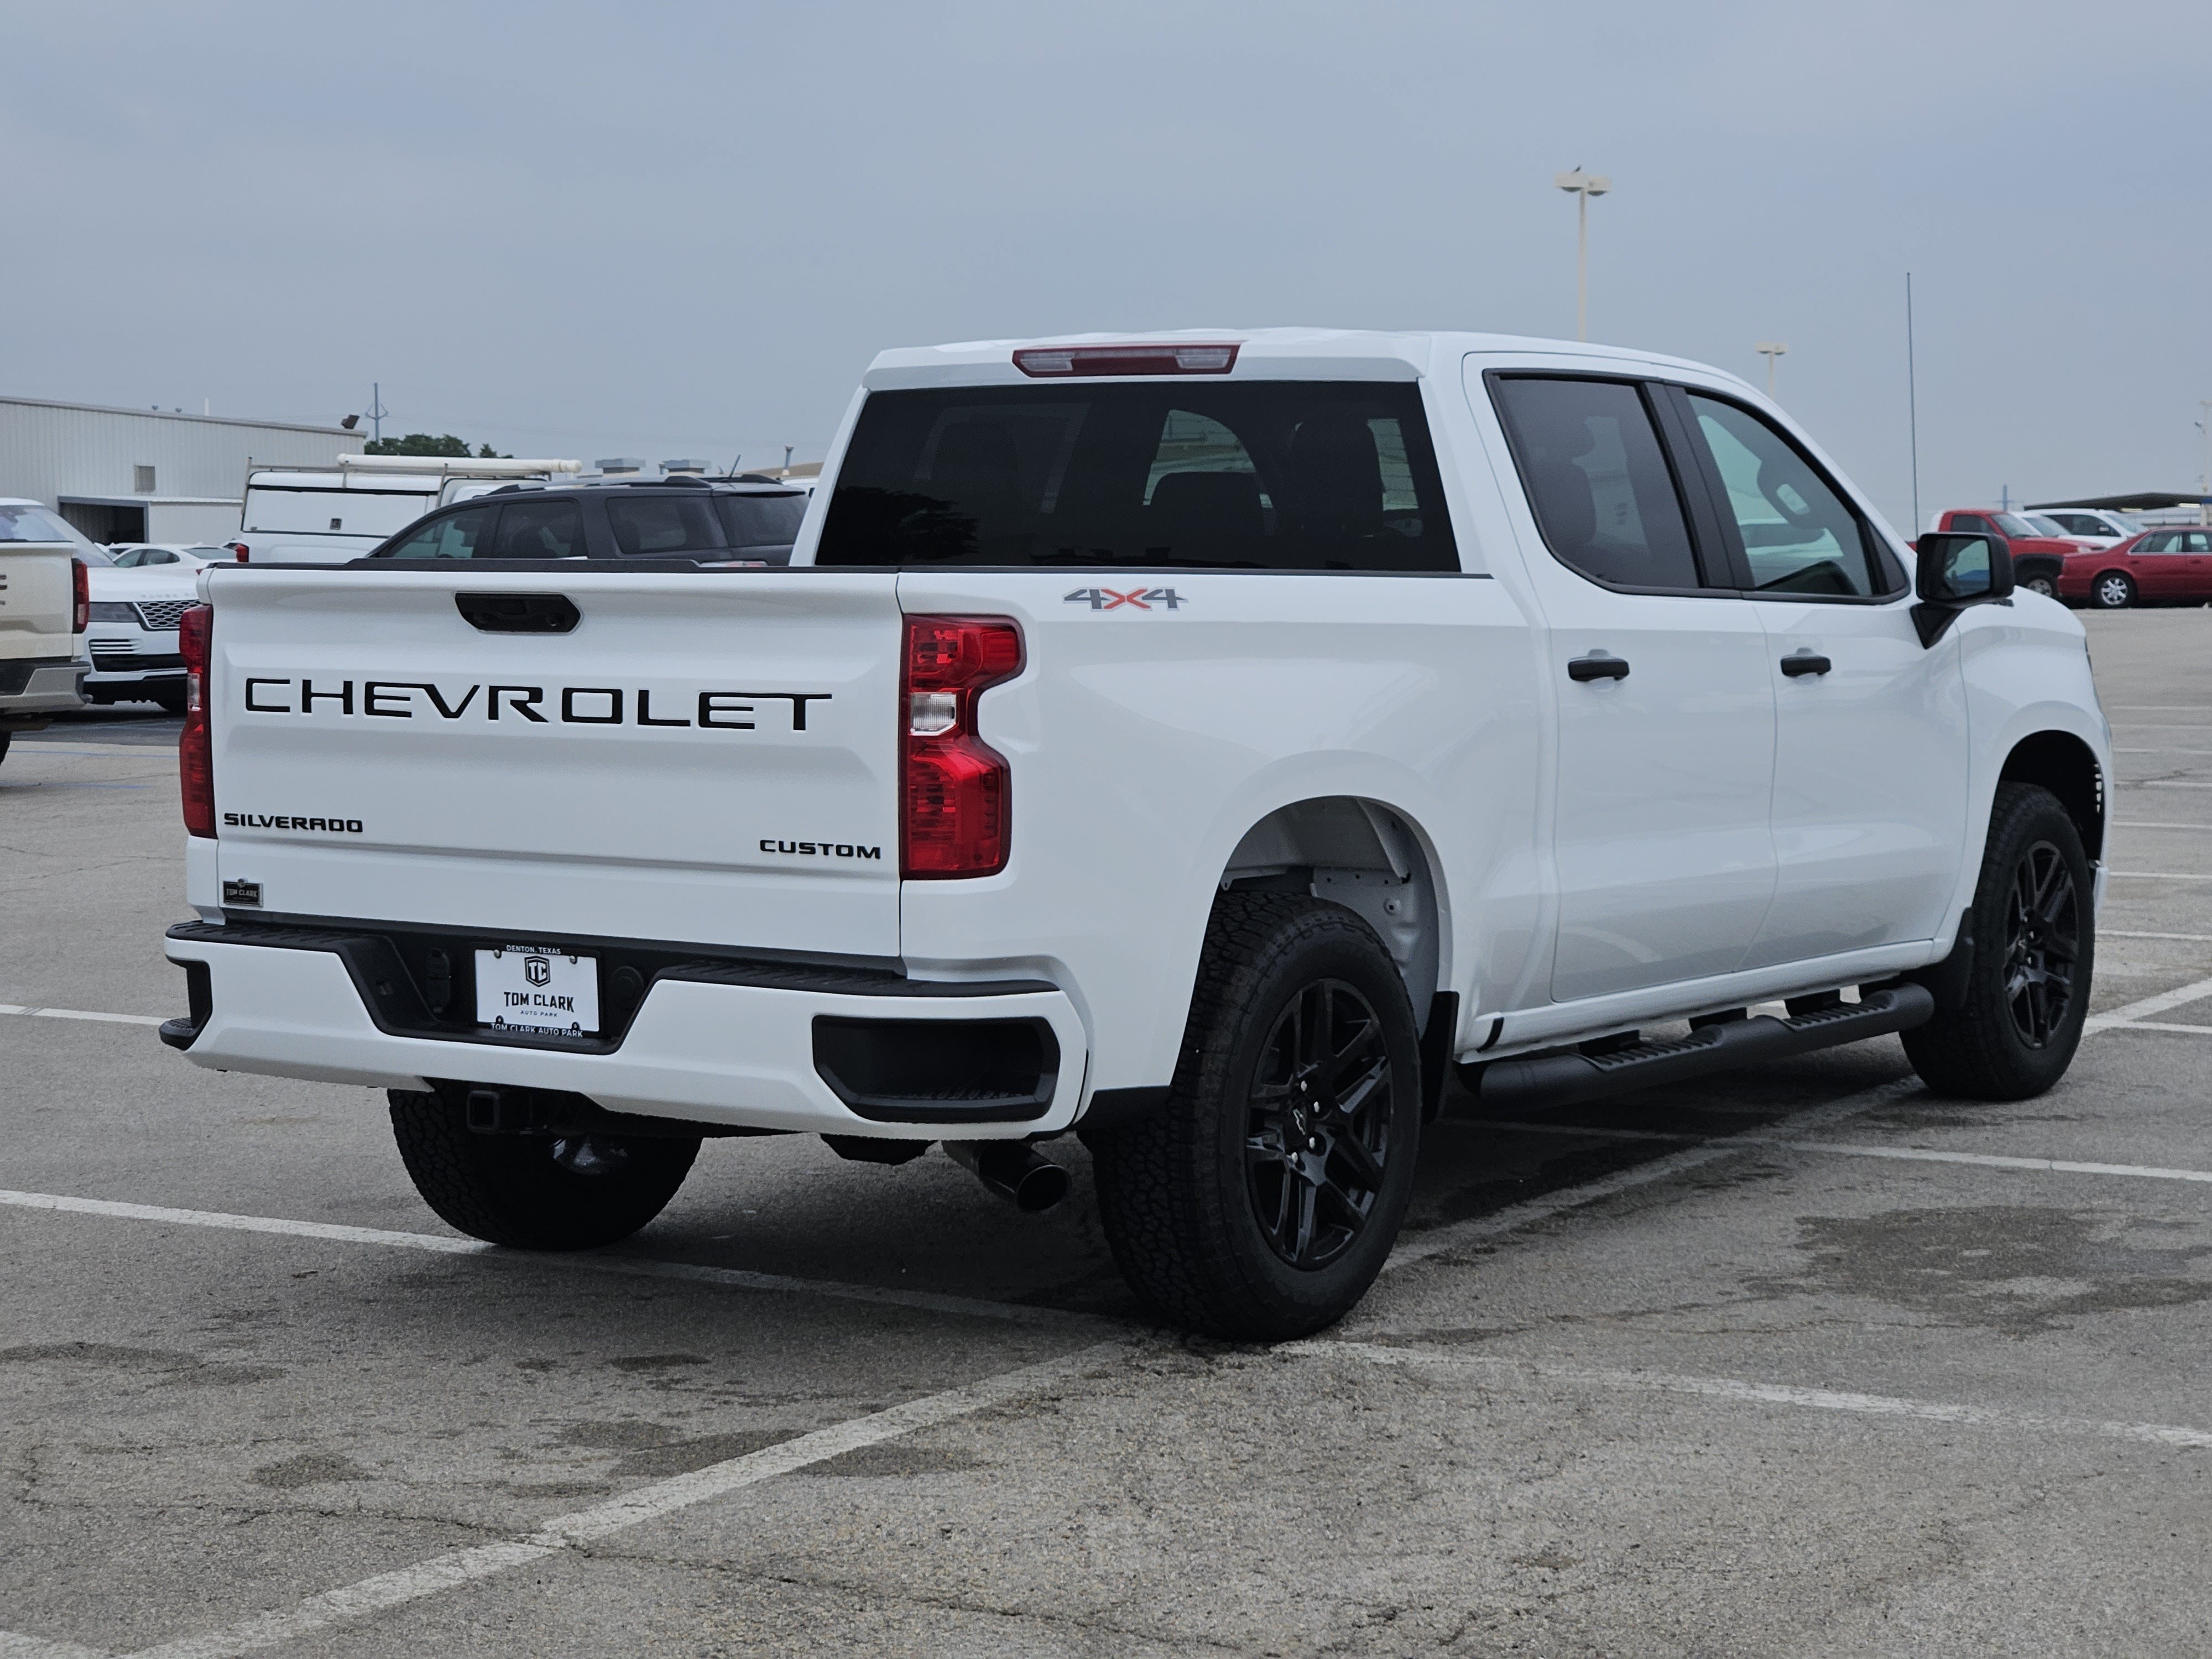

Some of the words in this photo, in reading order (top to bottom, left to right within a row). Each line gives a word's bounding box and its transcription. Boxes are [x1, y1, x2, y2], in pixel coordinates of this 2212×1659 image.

[246, 677, 832, 731] CHEVROLET
[224, 813, 362, 832] SILVERADO
[760, 839, 880, 859] CUSTOM
[504, 992, 529, 1006] TOM
[534, 994, 575, 1013] CLARK
[538, 1027, 559, 1036] AUTO
[562, 1030, 583, 1038] PARK
